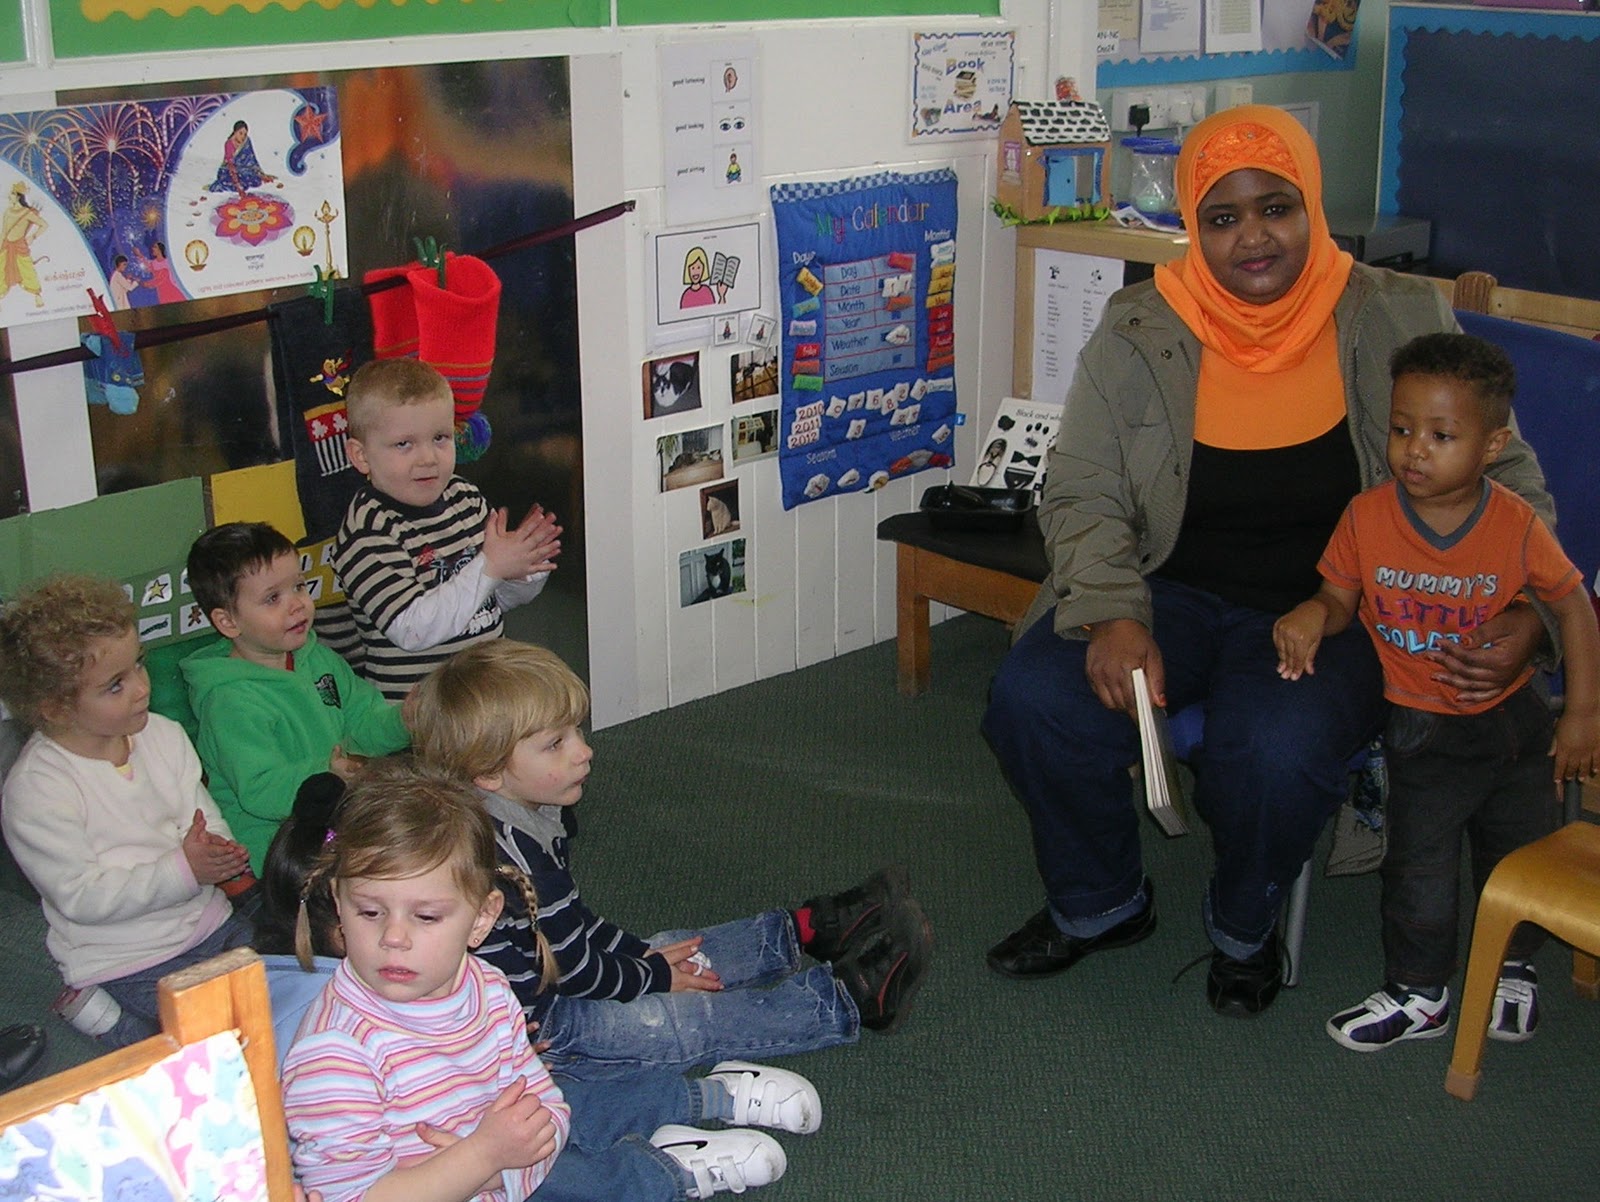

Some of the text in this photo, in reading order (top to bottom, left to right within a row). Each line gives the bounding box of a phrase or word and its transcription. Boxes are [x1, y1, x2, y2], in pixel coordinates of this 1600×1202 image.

[945, 58, 986, 76] Book
[943, 99, 982, 114] Area
[815, 198, 930, 244] My Calendar
[840, 265, 858, 279] Day
[840, 285, 861, 298] Date
[837, 300, 865, 313] Month
[842, 317, 861, 329] Year
[831, 335, 869, 351] Weather
[829, 363, 859, 377] Season
[899, 388, 906, 399] 2
[798, 403, 825, 419] 2010
[886, 398, 895, 410] 8
[794, 418, 820, 434] 2011
[853, 425, 862, 437] 3
[790, 432, 817, 448] 2012
[307, 580, 319, 596] 7
[1375, 566, 1498, 599] MUMMY'S
[1375, 595, 1489, 630] LITTLE
